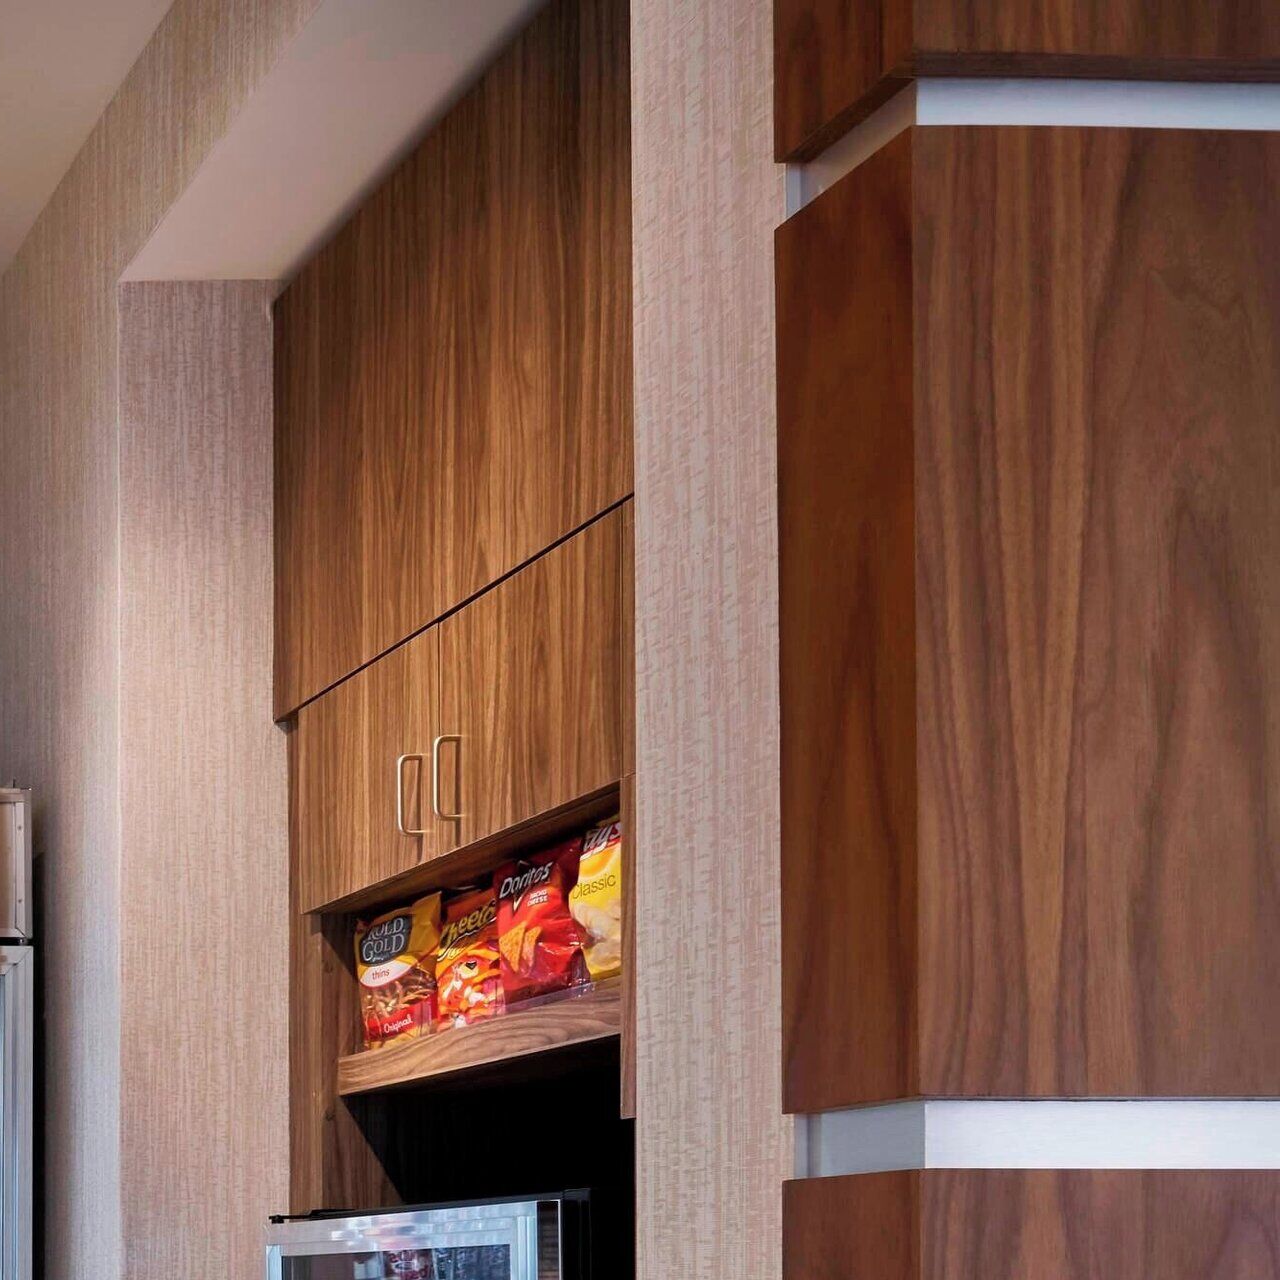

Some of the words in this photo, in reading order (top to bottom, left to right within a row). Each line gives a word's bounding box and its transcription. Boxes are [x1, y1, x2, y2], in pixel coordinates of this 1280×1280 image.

[499, 861, 554, 899] Doritos
[572, 873, 617, 900] Classic
[362, 934, 405, 961] GOLD
[372, 969, 390, 980] thins
[384, 1014, 413, 1034] Original
